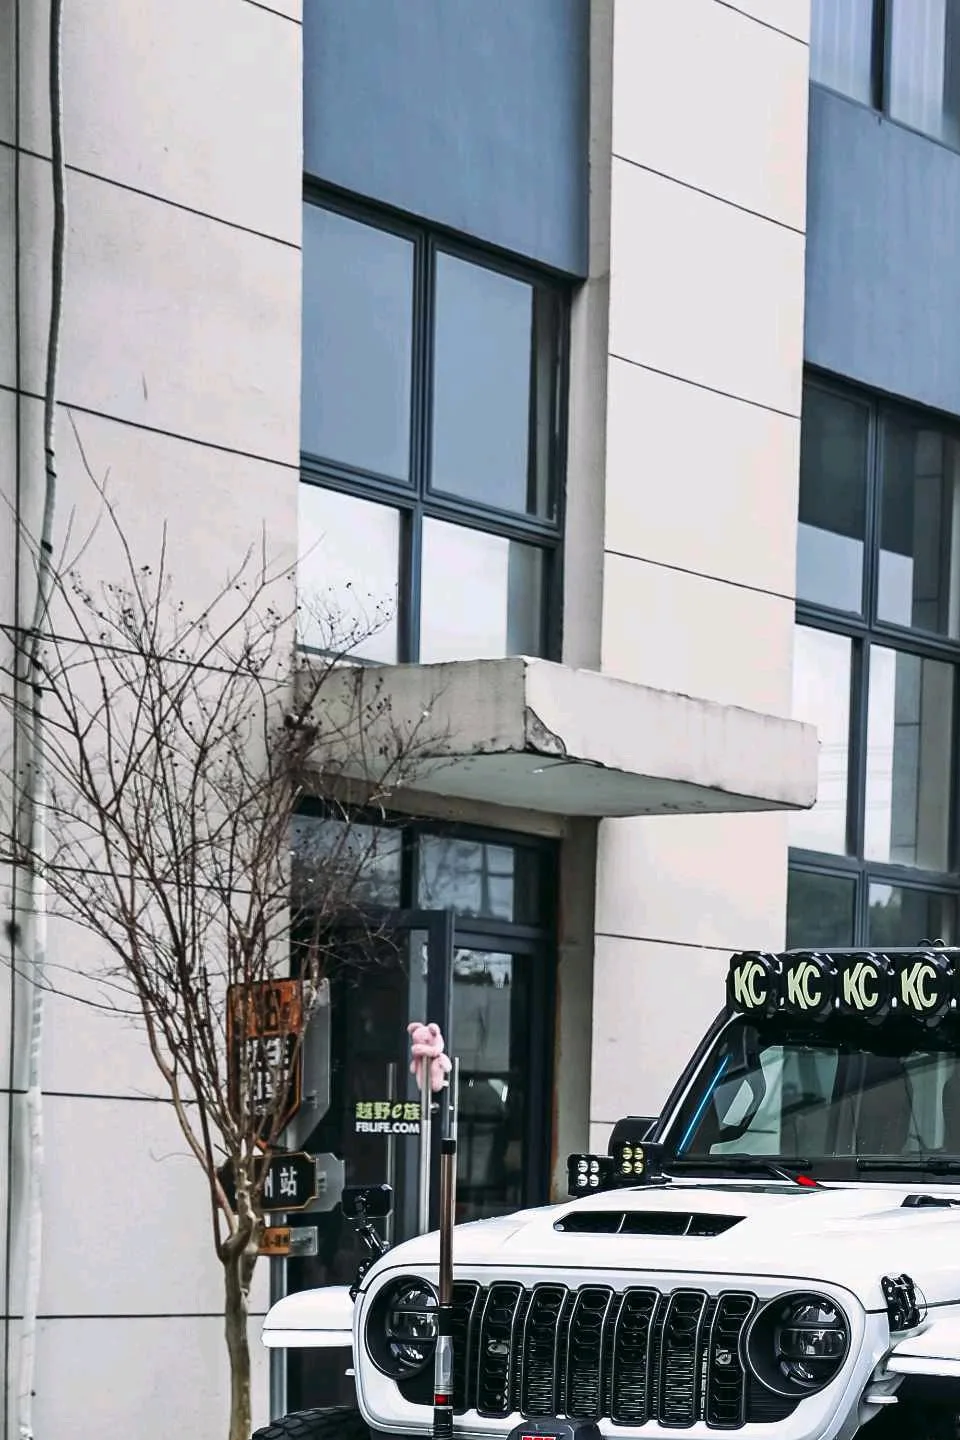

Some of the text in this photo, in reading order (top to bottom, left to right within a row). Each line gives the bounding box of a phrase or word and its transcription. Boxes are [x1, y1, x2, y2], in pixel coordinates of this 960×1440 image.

[734, 960, 766, 1007] KC
[787, 962, 822, 1005] KC
[843, 964, 878, 1008] KC
[900, 963, 937, 1008] KC
[355, 1121, 420, 1134] FBLIFE.COM
